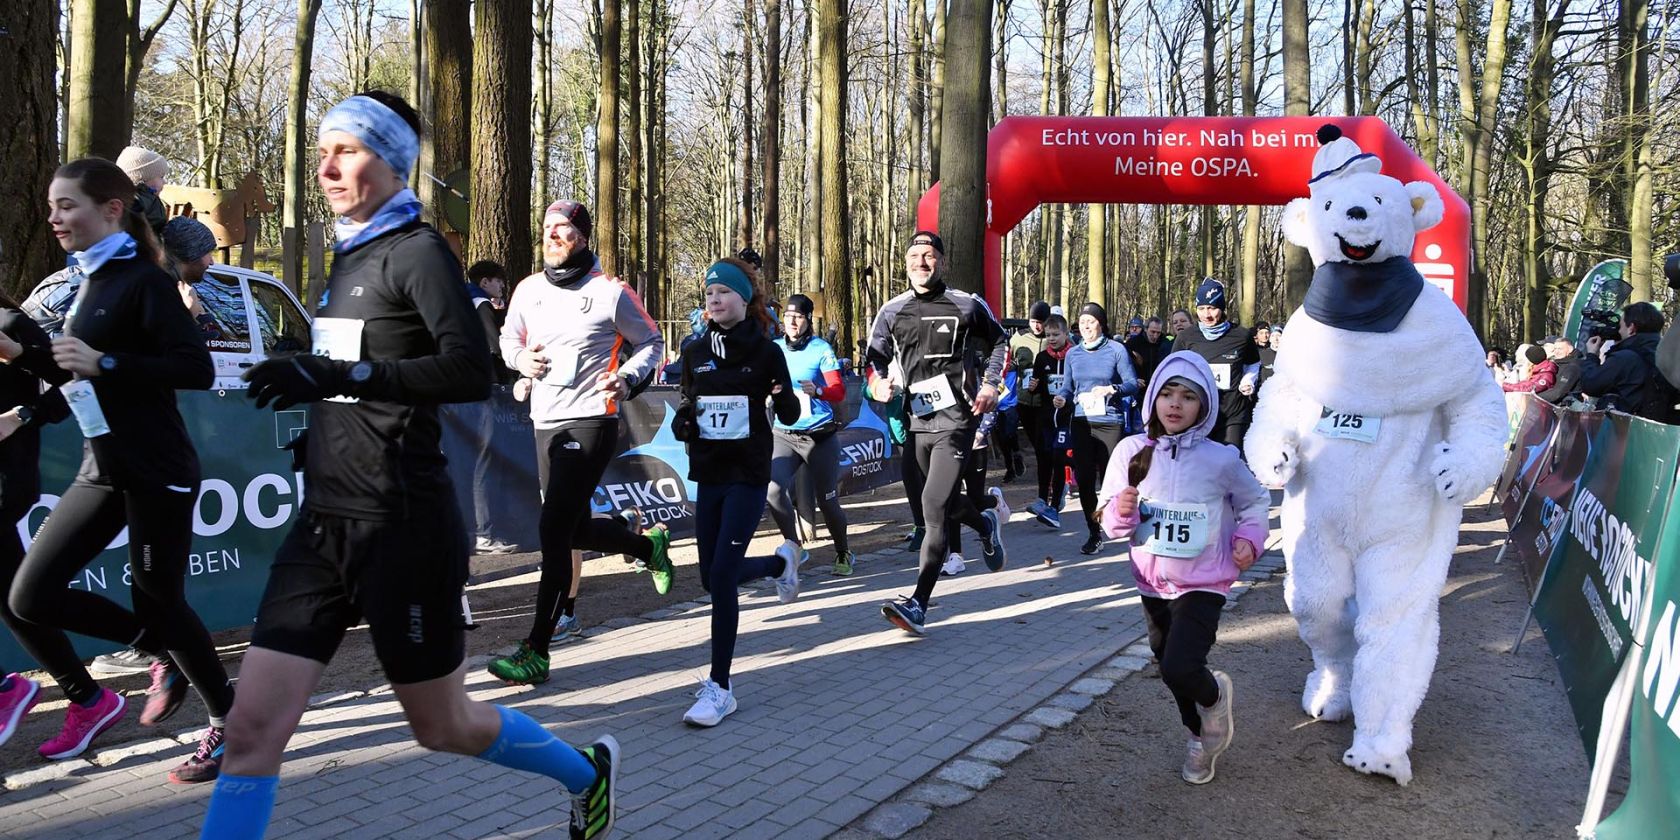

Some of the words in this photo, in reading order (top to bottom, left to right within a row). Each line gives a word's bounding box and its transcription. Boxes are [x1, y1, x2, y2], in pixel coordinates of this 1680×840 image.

[1041, 128, 1090, 146] Echt
[1094, 133, 1136, 146] von
[1143, 128, 1192, 147] hier.
[1200, 129, 1245, 147] Nah
[1252, 129, 1287, 148] bei
[1114, 156, 1184, 177] Meine
[1190, 157, 1259, 178] OSPA.
[210, 340, 250, 349] SPONSOREN
[709, 412, 729, 429] 17
[1332, 413, 1364, 429] 125
[1057, 431, 1067, 444] 5
[852, 460, 882, 478] ROSTOCK
[638, 504, 692, 526] STOCK
[1570, 487, 1606, 561] NEUE
[1151, 520, 1191, 544] 115
